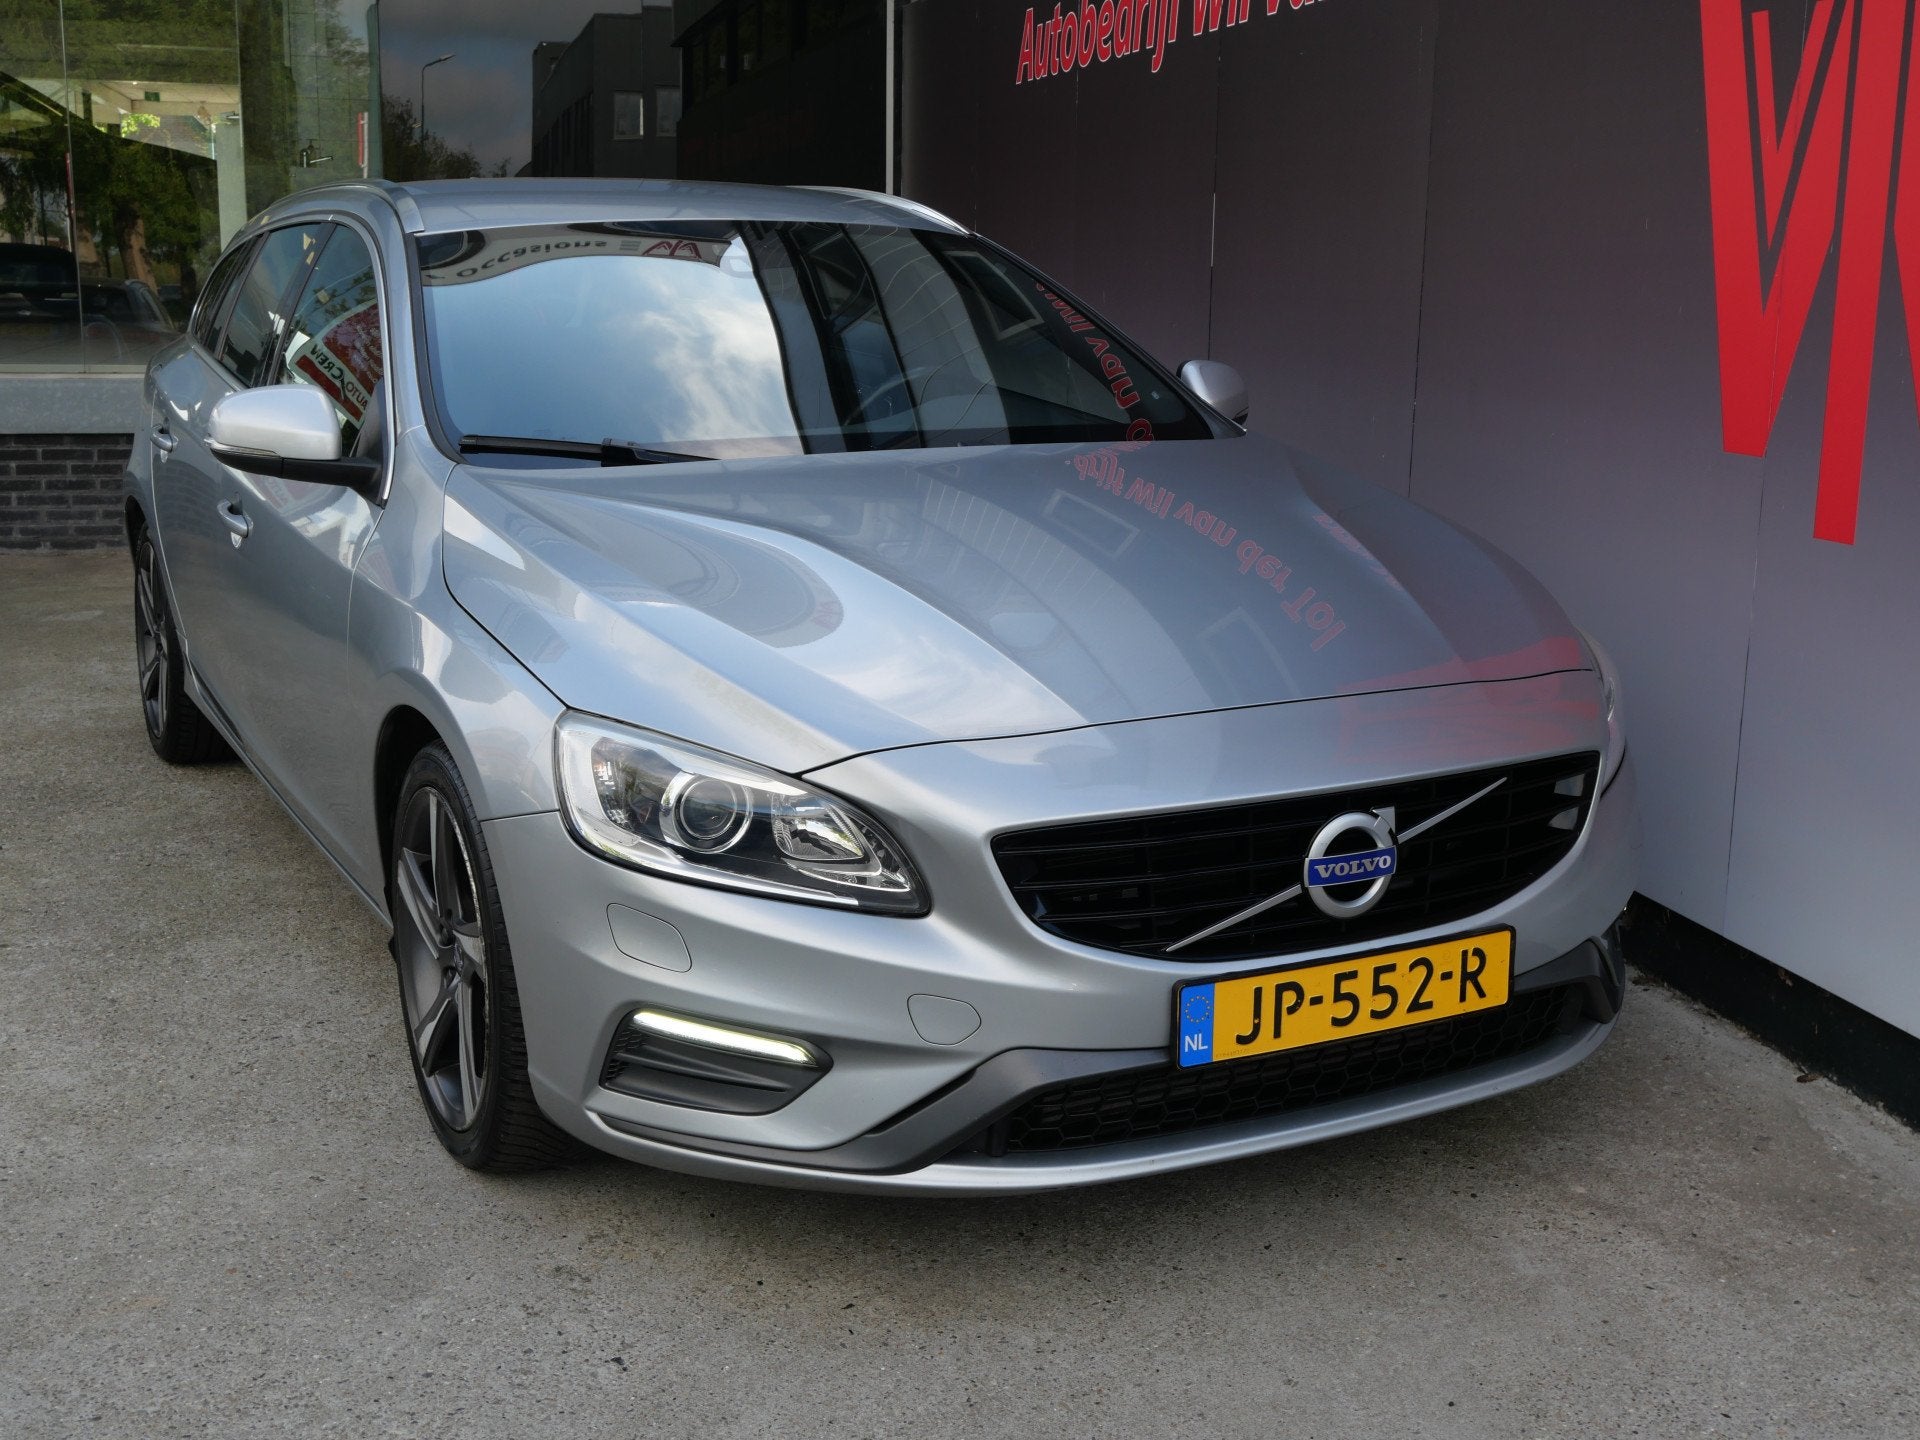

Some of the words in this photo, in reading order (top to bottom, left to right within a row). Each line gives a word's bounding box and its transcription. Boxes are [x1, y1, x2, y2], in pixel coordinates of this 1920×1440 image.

[1314, 855, 1392, 879] VOLVO
[1235, 947, 1487, 1045] JP-552-R
[1184, 1033, 1208, 1053] NL
